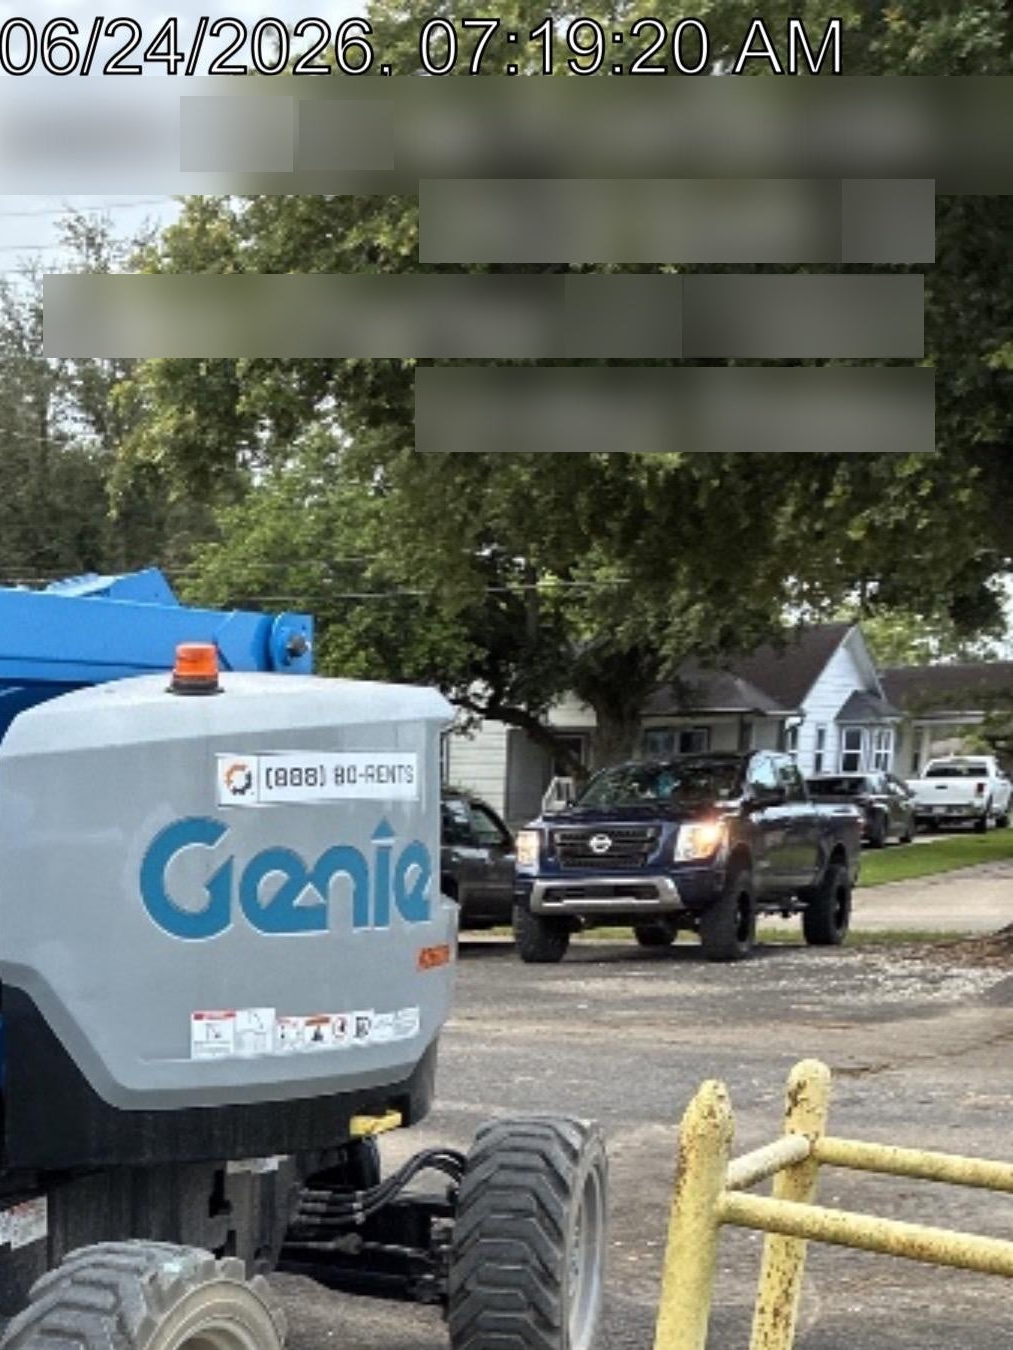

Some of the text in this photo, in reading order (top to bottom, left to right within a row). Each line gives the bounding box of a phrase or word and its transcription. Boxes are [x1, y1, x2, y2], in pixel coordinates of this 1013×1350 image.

[265, 763, 414, 789] (888) 80-RENTS
[140, 815, 431, 940] Genie
